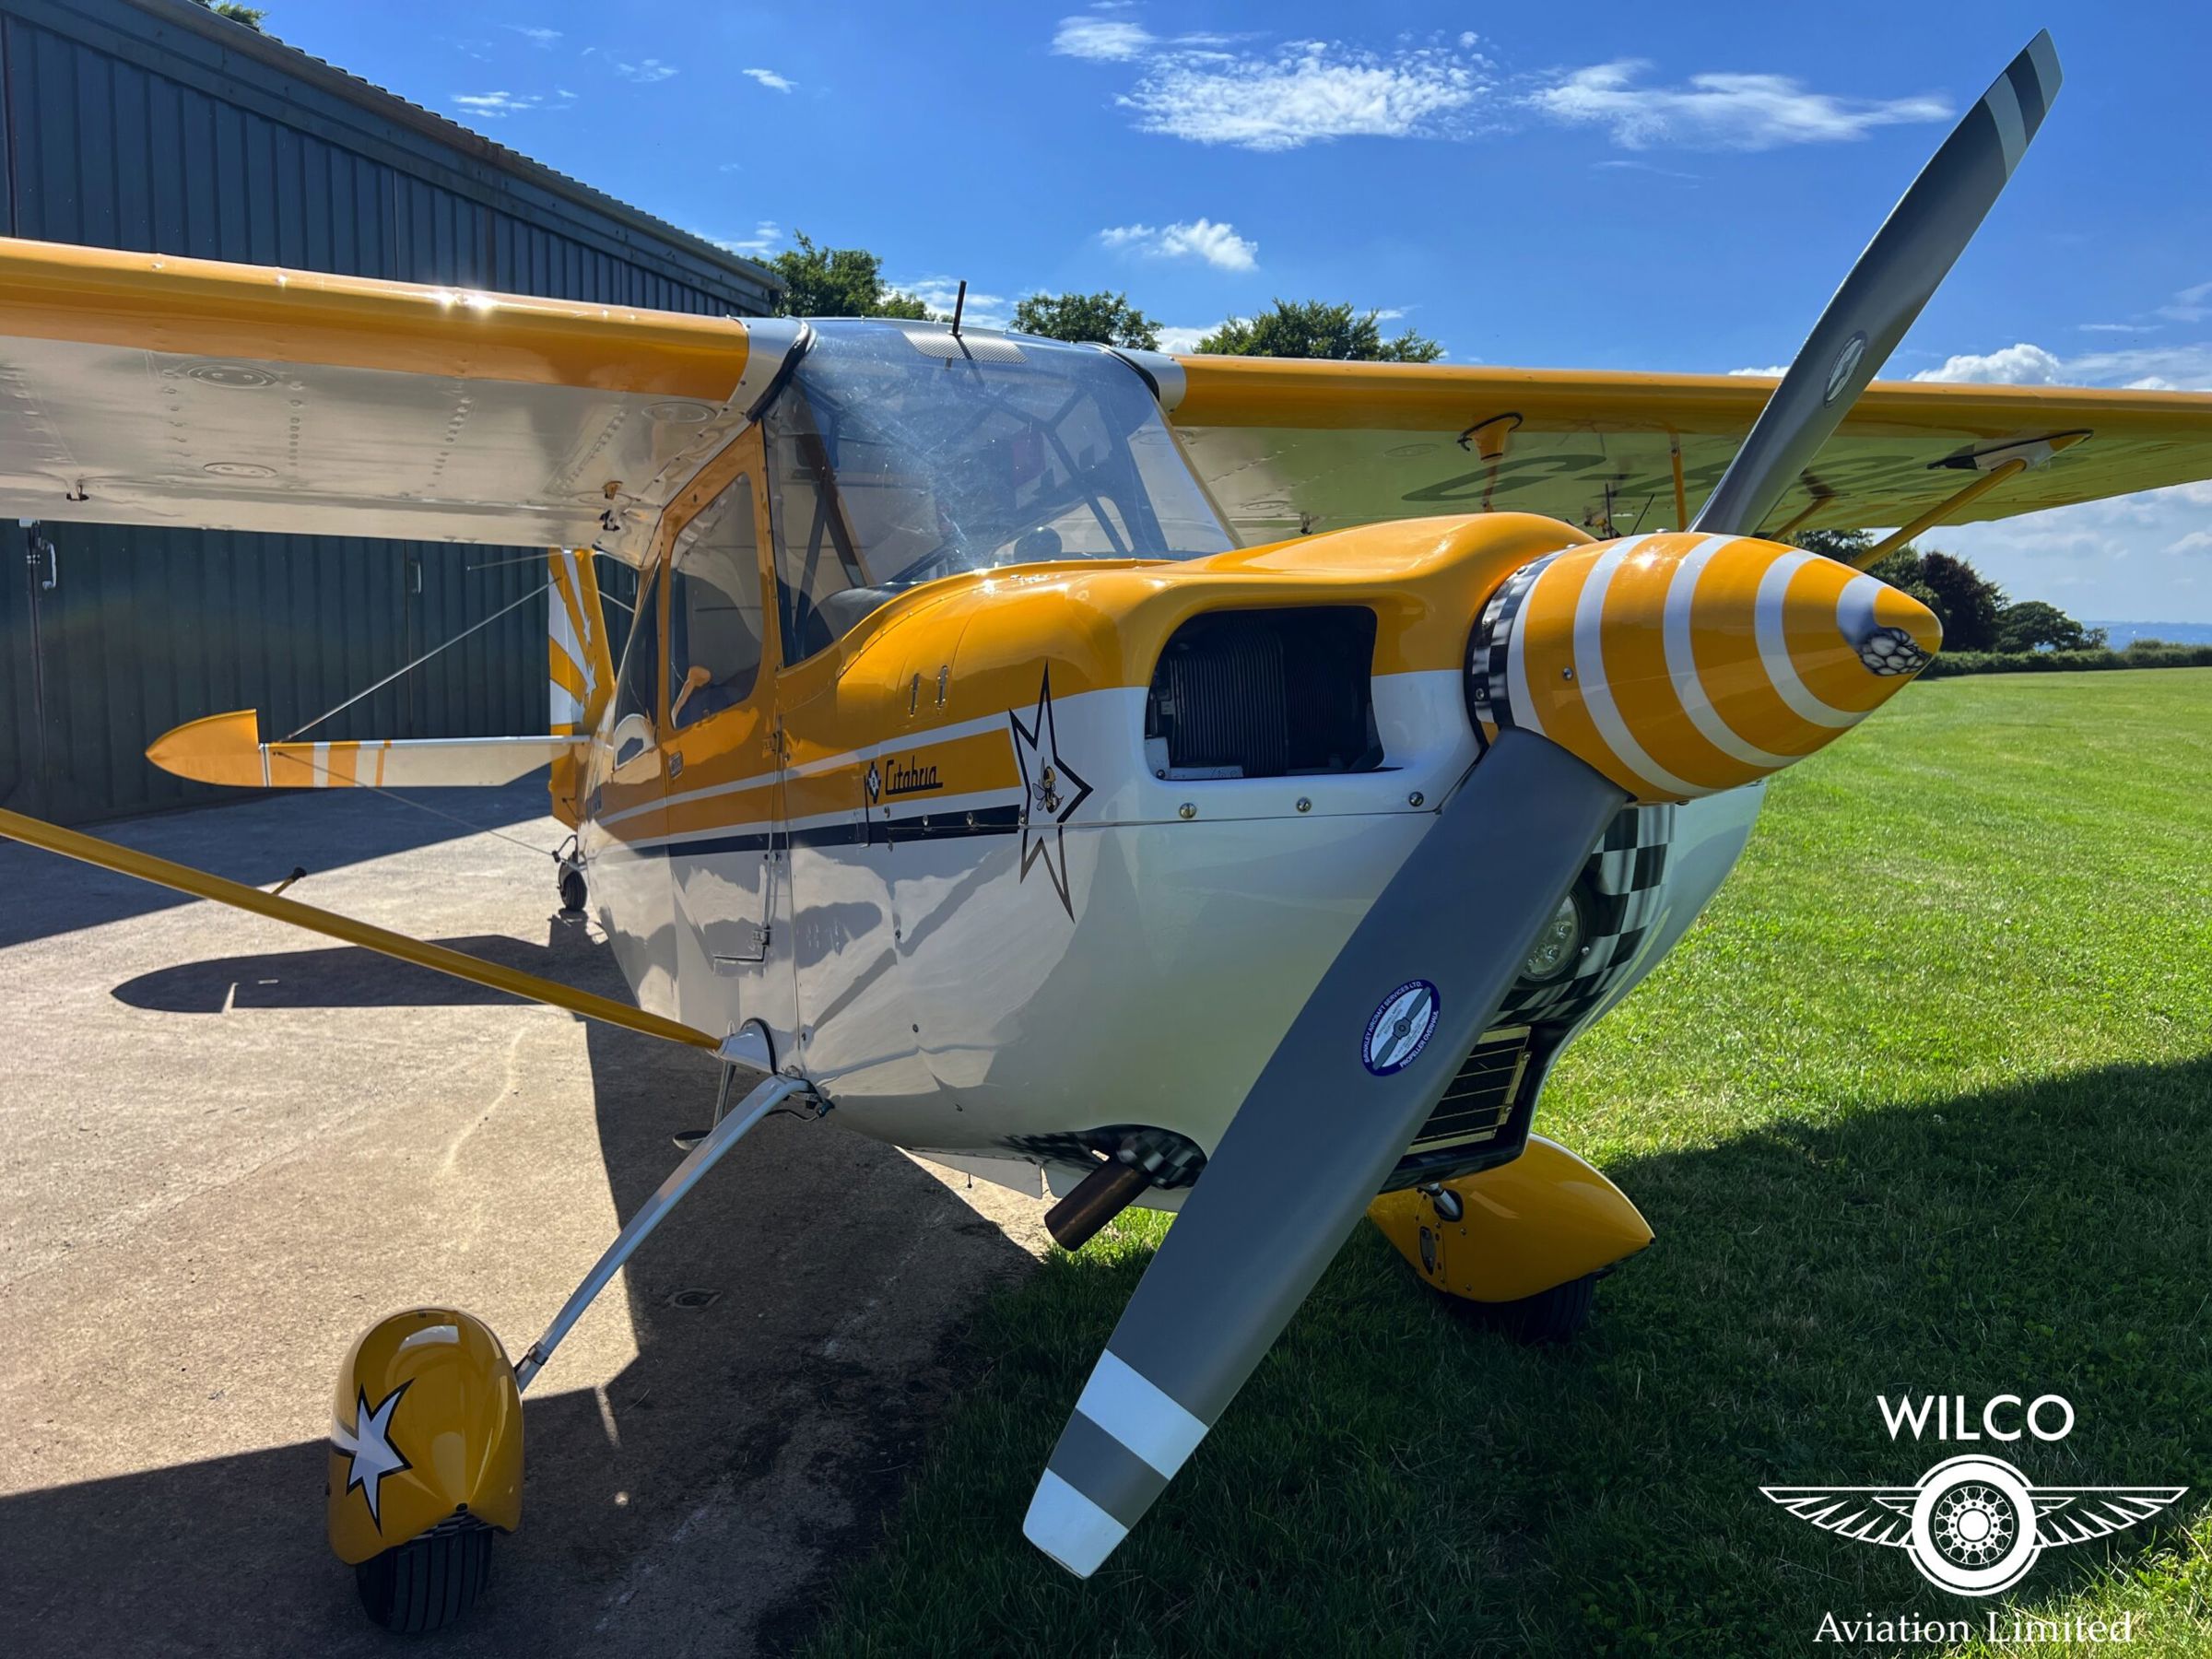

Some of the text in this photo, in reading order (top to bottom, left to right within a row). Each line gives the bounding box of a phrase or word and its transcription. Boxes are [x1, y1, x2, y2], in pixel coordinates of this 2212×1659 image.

[886, 755, 943, 795] Citabria
[1368, 1006, 1386, 1032] AIRCRAFT
[1383, 985, 1410, 1006] SERVICES
[1399, 1040, 1427, 1068] PROPELLER
[1423, 1010, 1439, 1041] OVERHAUL
